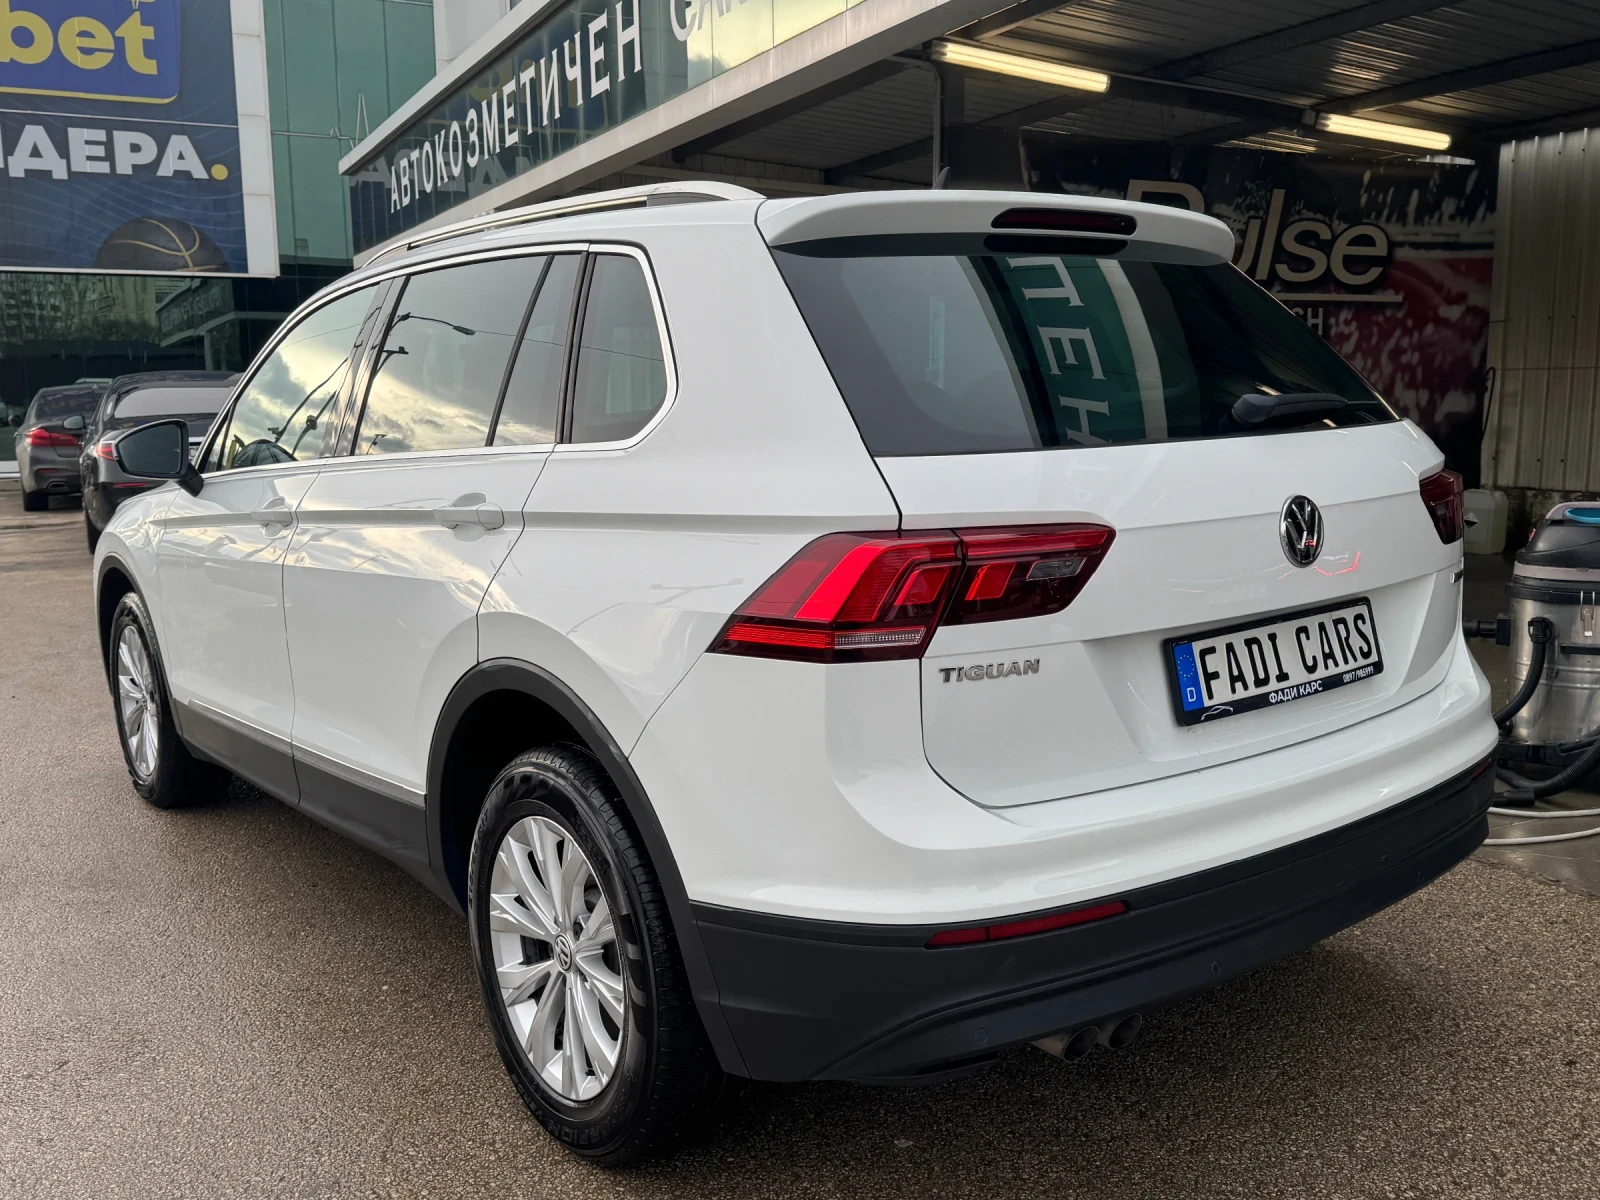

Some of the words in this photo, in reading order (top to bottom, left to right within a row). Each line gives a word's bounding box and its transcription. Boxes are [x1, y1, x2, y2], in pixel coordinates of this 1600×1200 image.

[390, 0, 643, 214] АВТОКОЗМЕТИЧЕН
[0, 124, 229, 180] ДЕРА.
[938, 658, 1041, 684] TIGUAN
[1199, 632, 1290, 700] FADI
[1295, 613, 1373, 675] CARS
[1186, 686, 1197, 702] D
[1268, 689, 1298, 704] ФАДИ
[1299, 680, 1324, 699] КАРС
